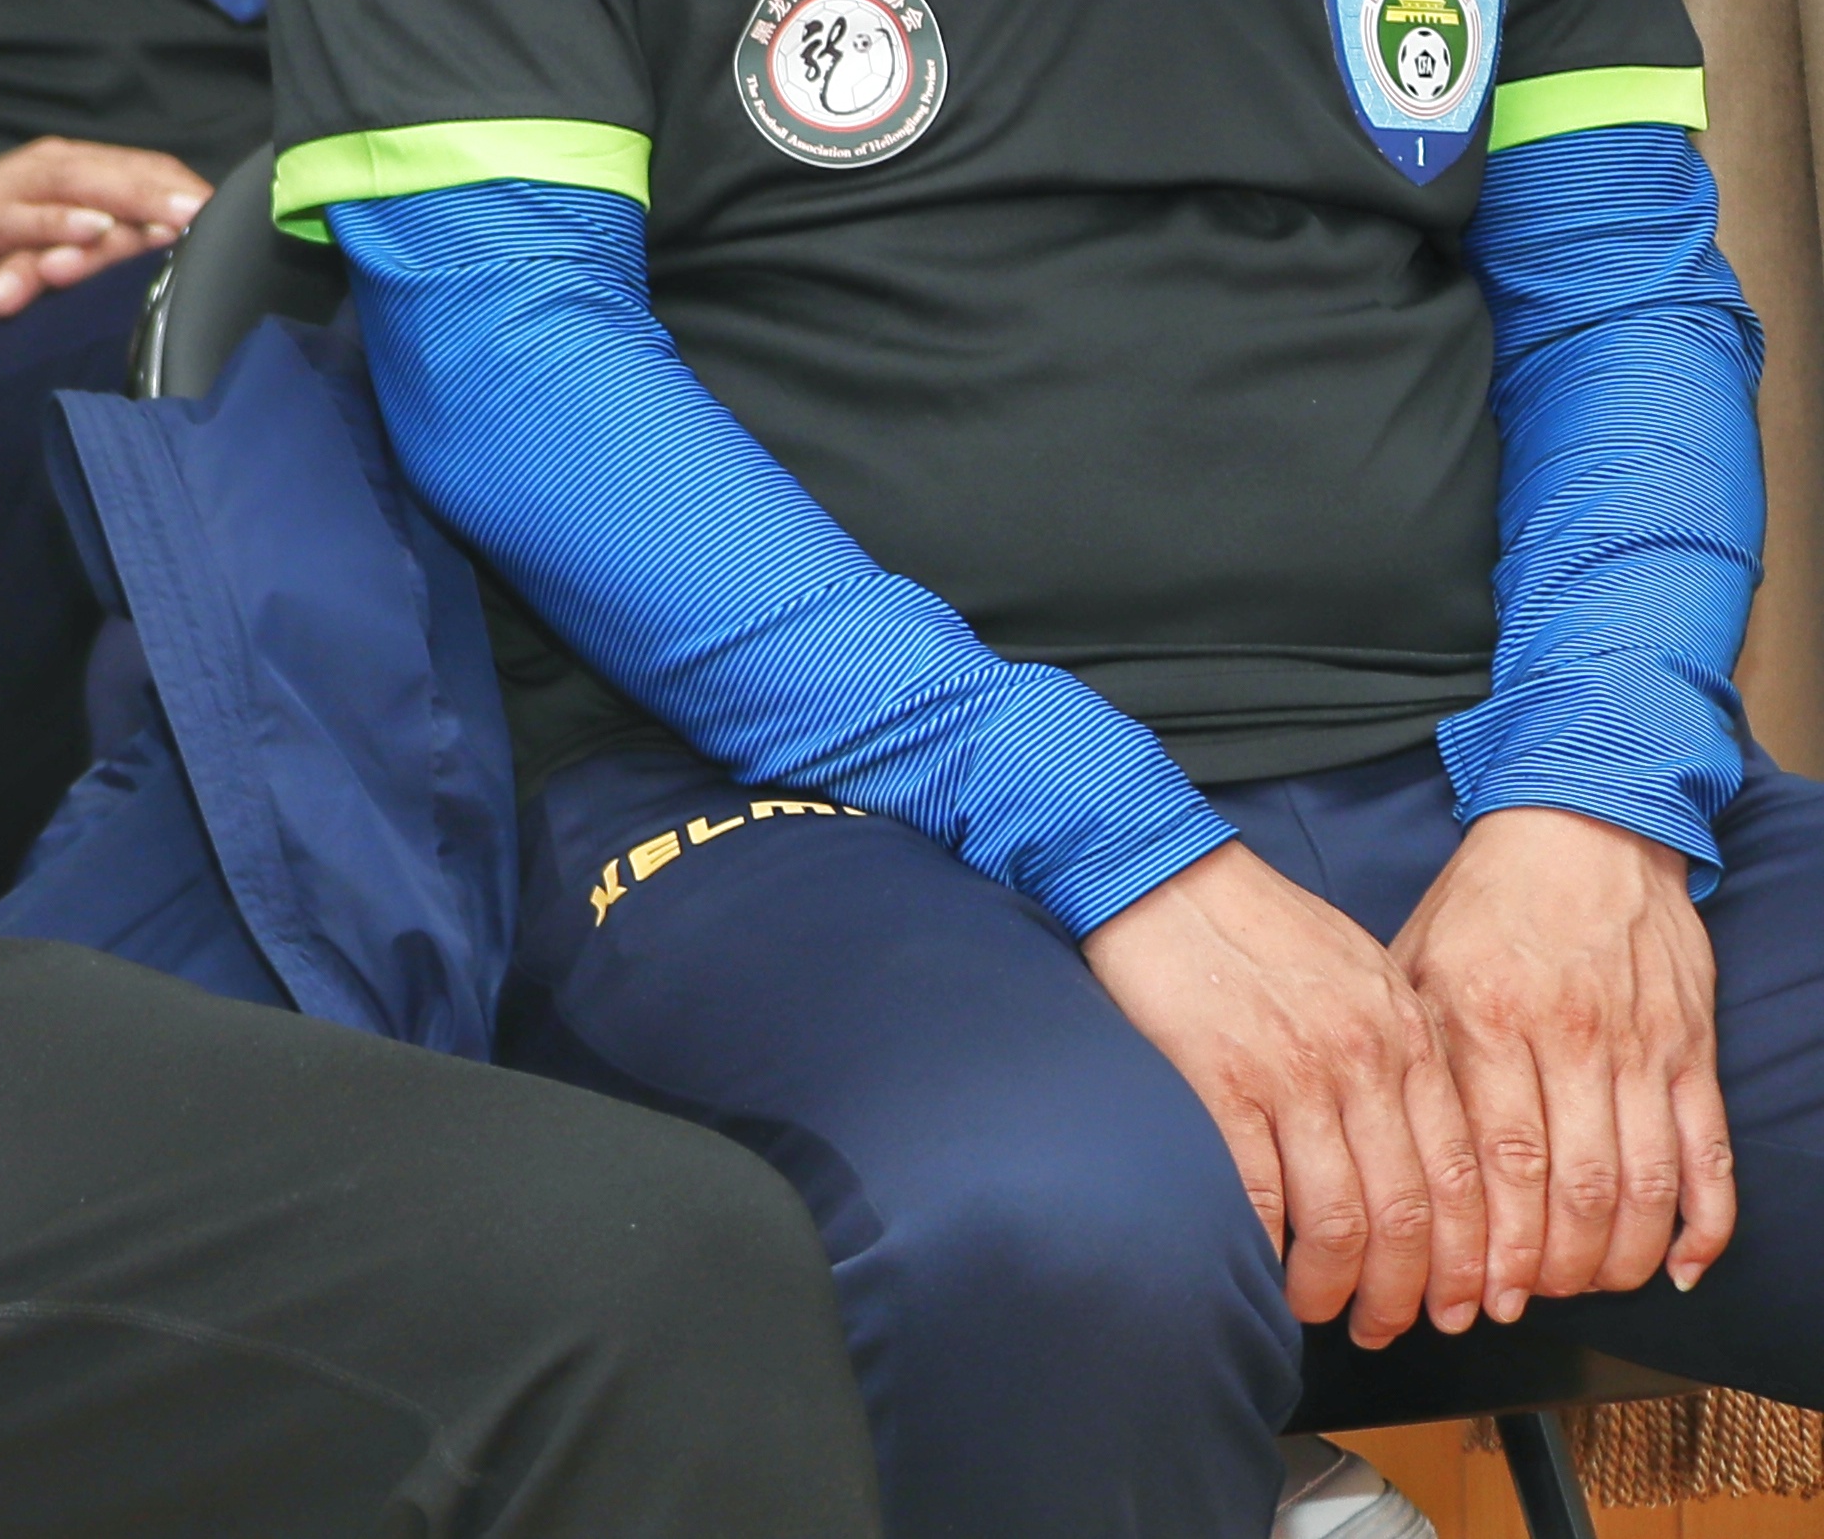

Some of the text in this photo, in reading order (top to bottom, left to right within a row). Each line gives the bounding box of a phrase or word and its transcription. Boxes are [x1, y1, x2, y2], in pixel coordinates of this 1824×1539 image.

[1417, 55, 1433, 76] CFA
[787, 132, 852, 158] Association
[854, 143, 868, 156] of
